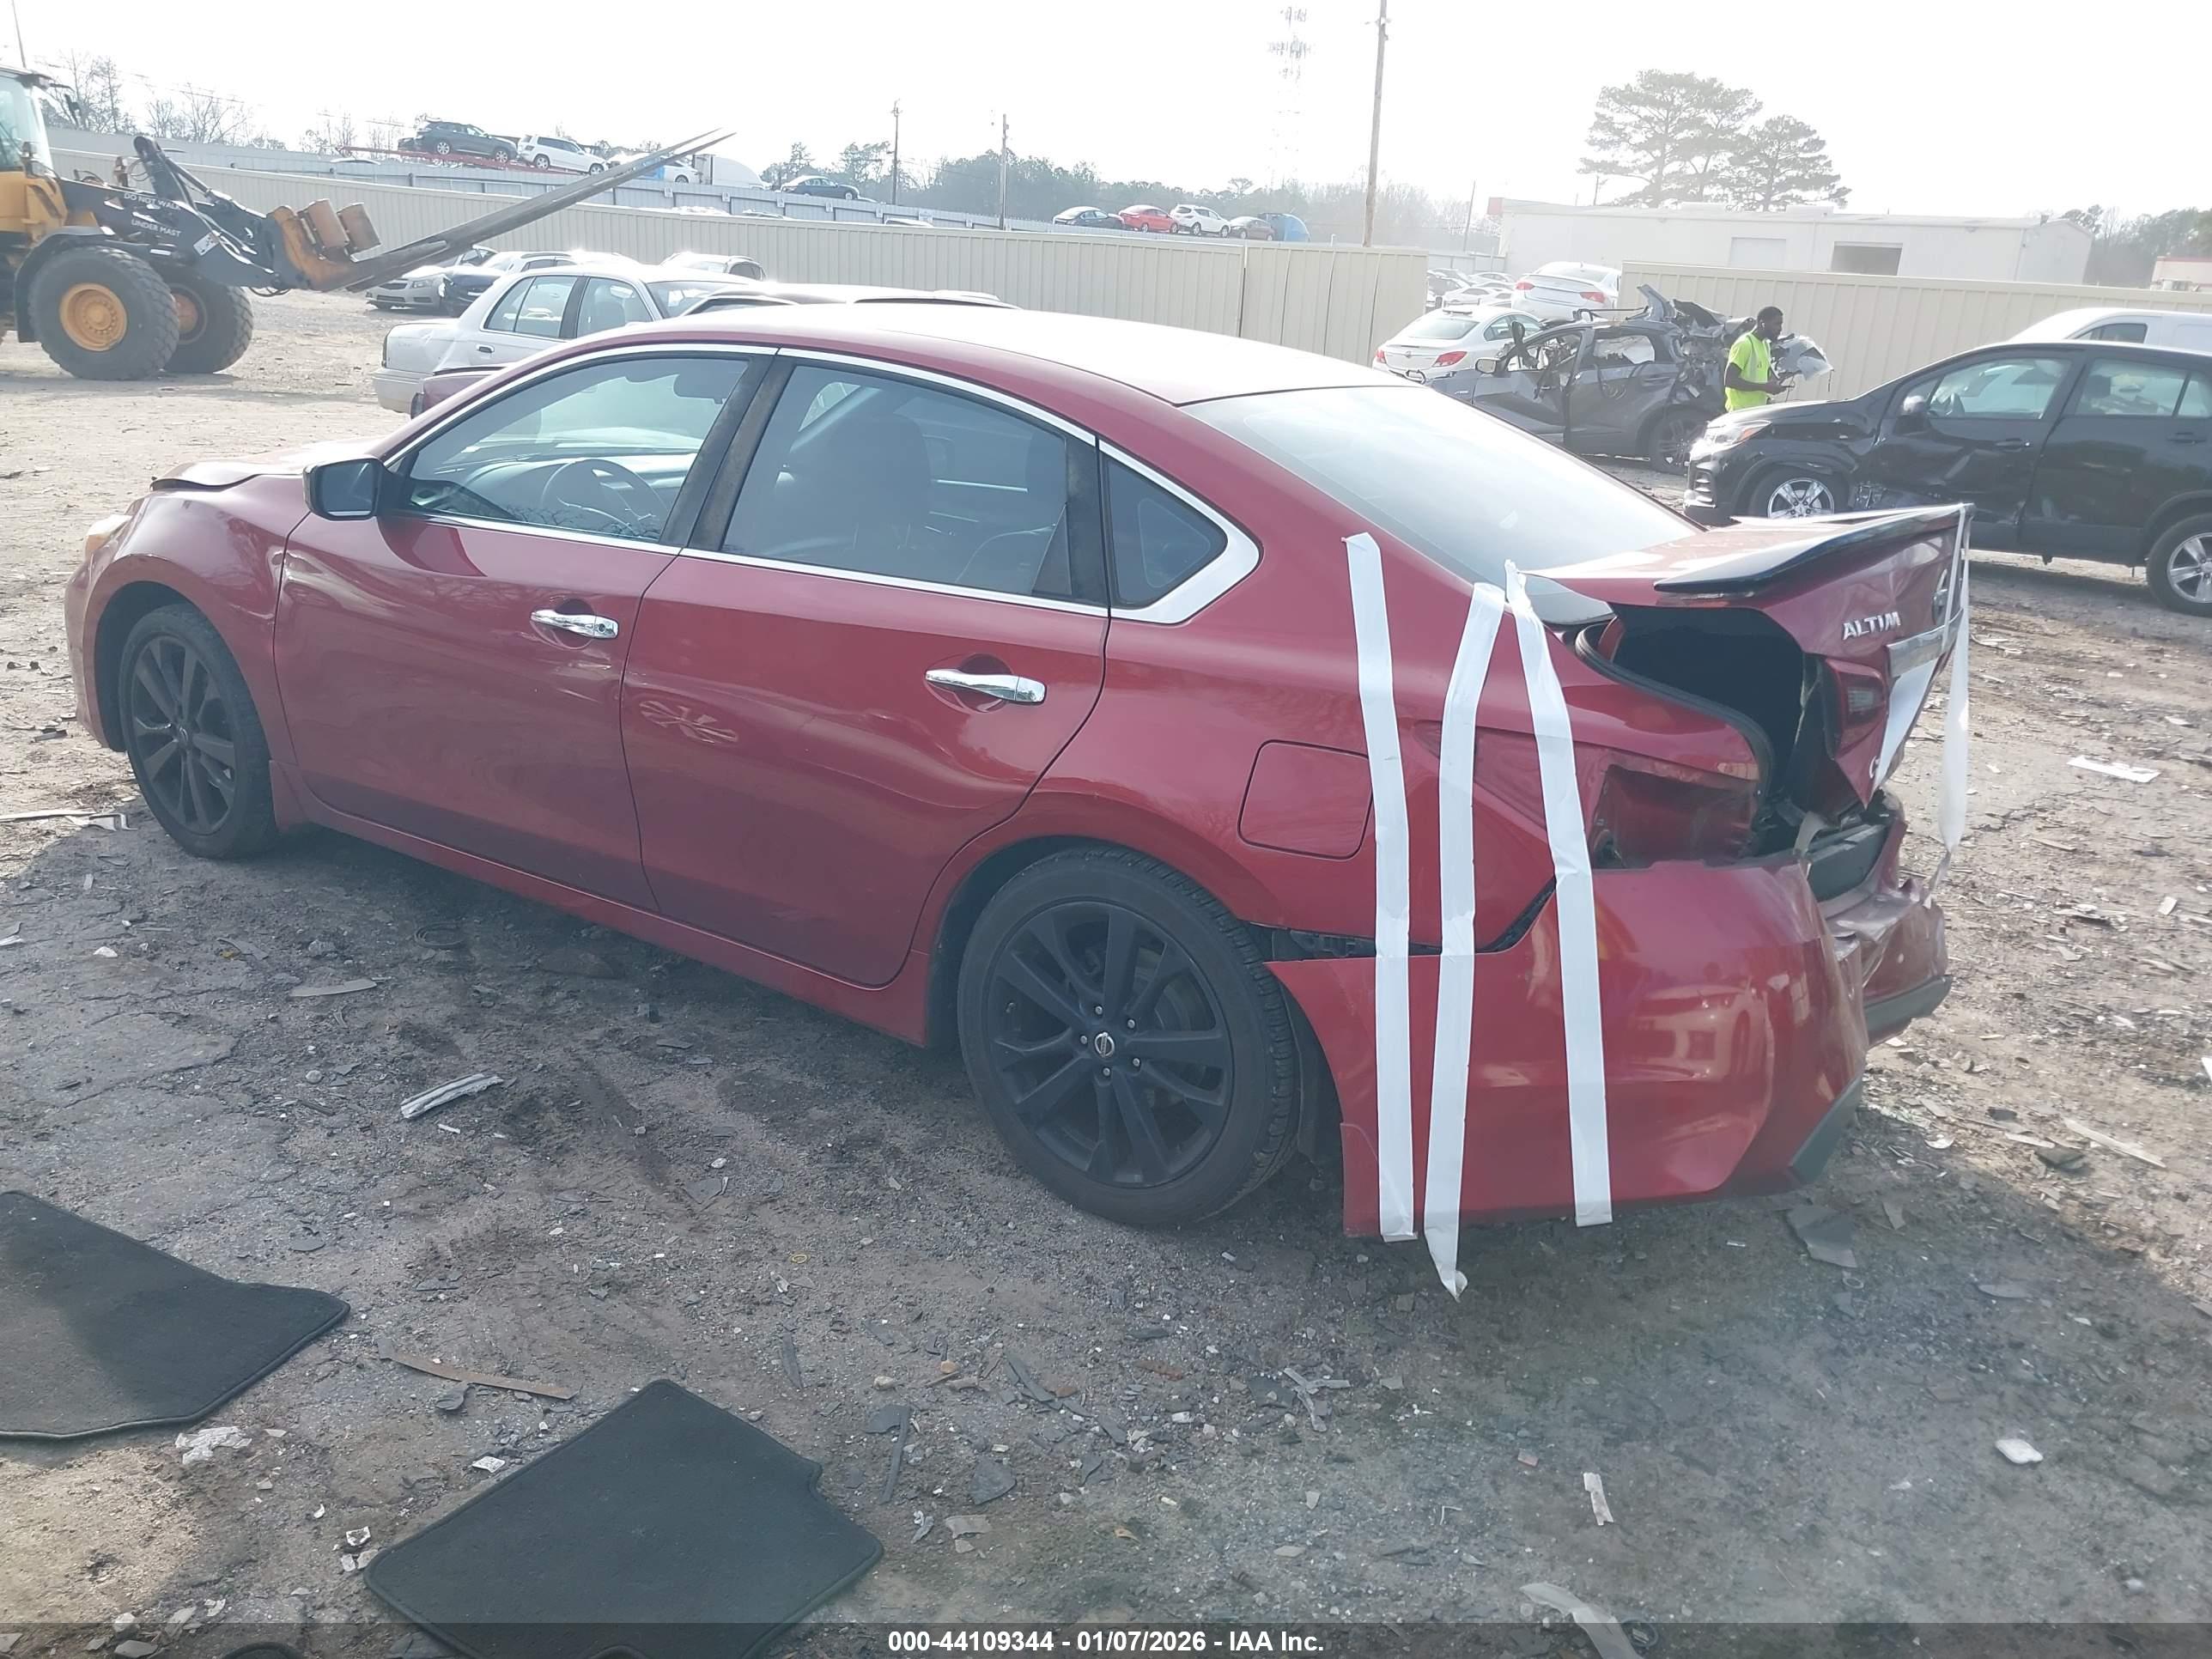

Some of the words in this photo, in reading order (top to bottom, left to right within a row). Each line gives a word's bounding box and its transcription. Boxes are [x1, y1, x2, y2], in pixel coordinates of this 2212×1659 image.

[138, 196, 156, 204] NOT
[131, 219, 159, 231] UNDER
[160, 226, 181, 237] MAST
[1843, 611, 1901, 641] ALTIM
